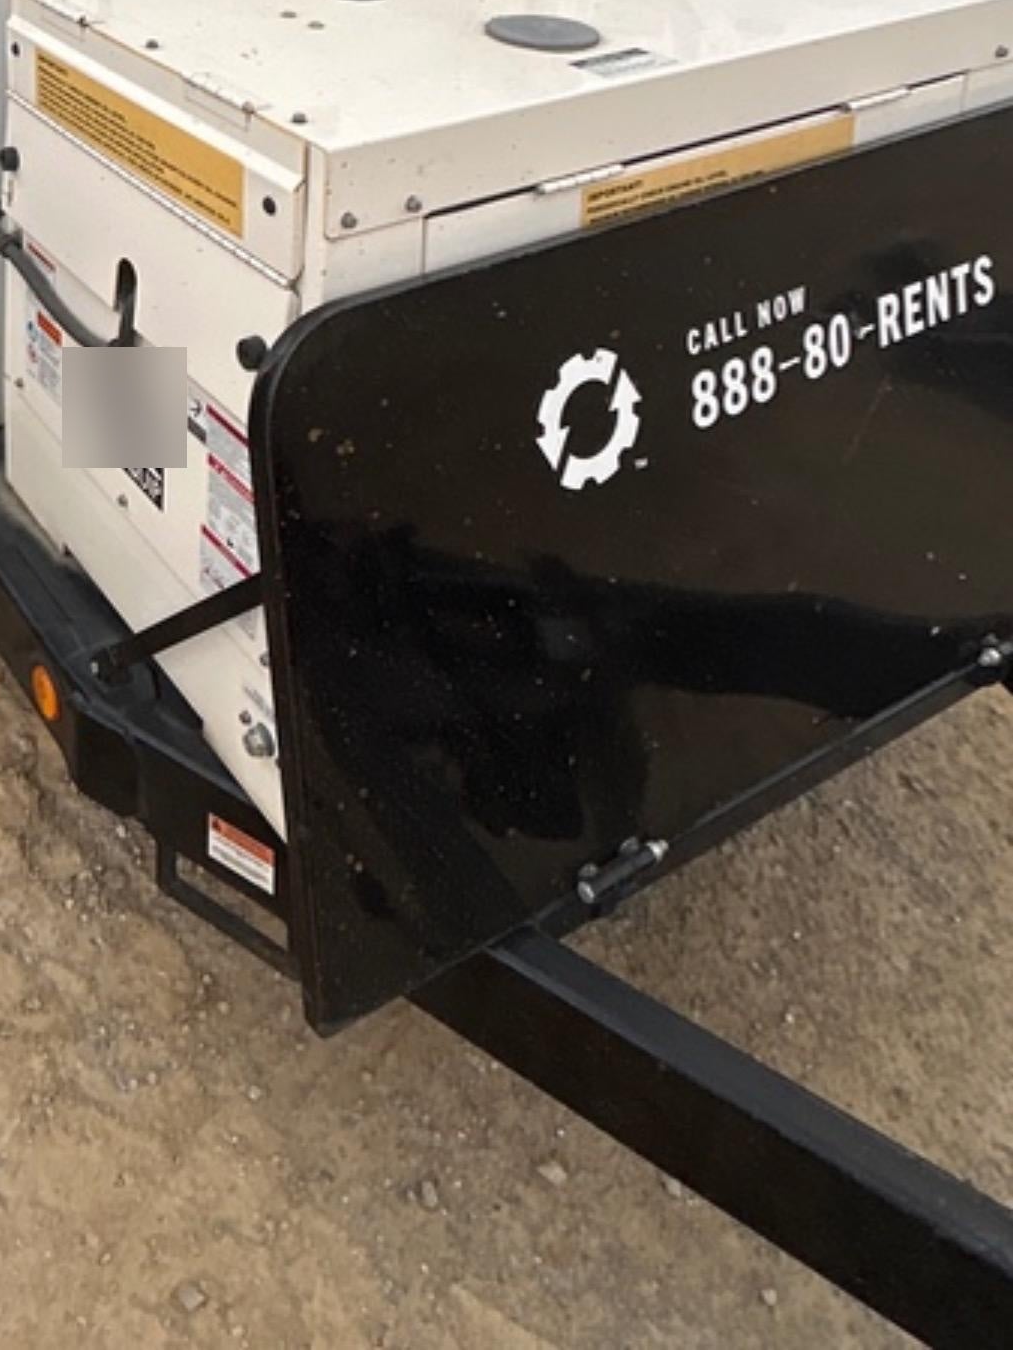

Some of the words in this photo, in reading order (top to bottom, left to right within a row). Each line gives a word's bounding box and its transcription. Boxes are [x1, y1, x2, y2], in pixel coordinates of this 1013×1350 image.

[687, 312, 748, 355] CALL
[757, 287, 806, 328] NOW
[691, 255, 995, 428] 888-80-RENTS
